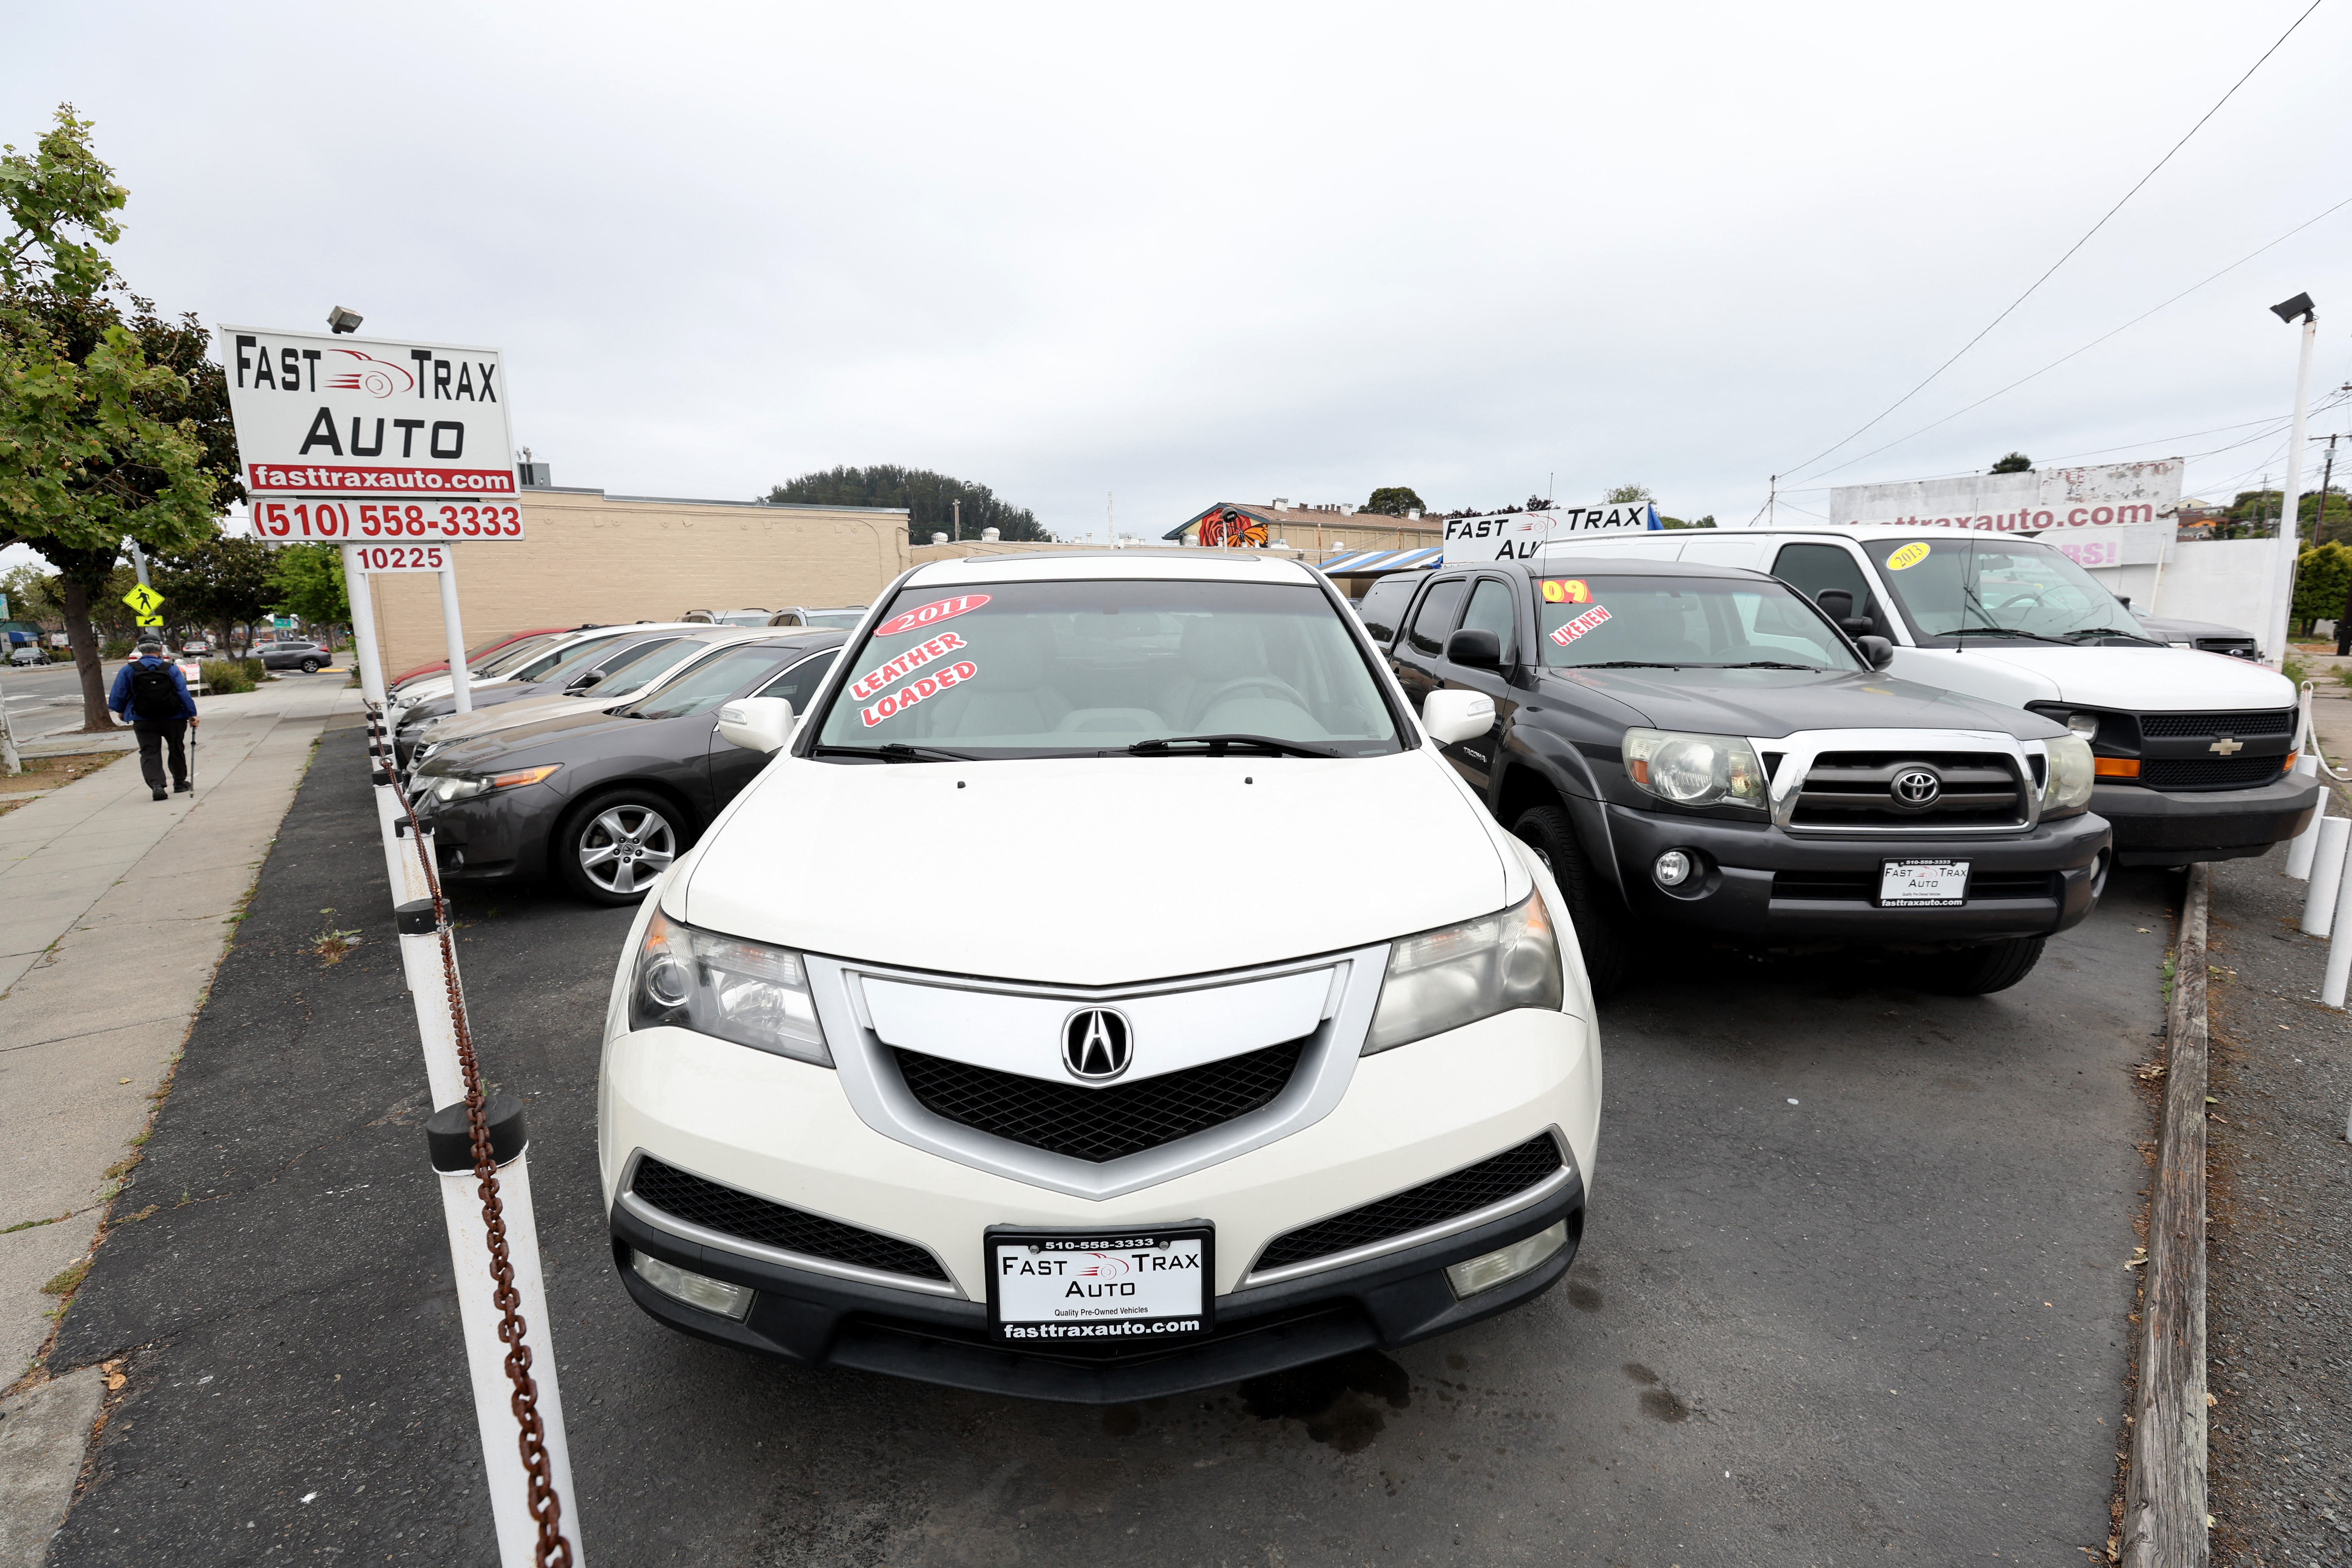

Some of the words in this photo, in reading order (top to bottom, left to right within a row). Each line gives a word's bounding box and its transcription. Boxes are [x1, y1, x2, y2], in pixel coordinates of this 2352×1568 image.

[236, 335, 321, 392] FAST
[411, 349, 497, 403] TRAX
[299, 407, 464, 459] AUTO
[256, 466, 509, 490] fasttraxauto.com
[254, 502, 348, 537] (510)
[360, 505, 521, 536] 558-3333
[1445, 519, 1509, 541] FAST
[1568, 506, 1644, 530] TRAX
[357, 548, 442, 569] 10225
[1895, 545, 1923, 567] 2013
[1542, 580, 1588, 603] 09
[898, 597, 971, 630] 2011
[853, 633, 965, 698] LEATHER
[863, 662, 975, 726] LOADED
[1885, 868, 1913, 877] FAST
[1940, 868, 1967, 877] TRAX
[1045, 1238, 1154, 1249] 510-558-3333
[1002, 1257, 1067, 1275] FAST
[1131, 1253, 1200, 1272] TRAX
[1065, 1281, 1135, 1298] AUTO
[1054, 1309, 1078, 1318] Quality
[1004, 1320, 1199, 1338] fasttraxauto.com
